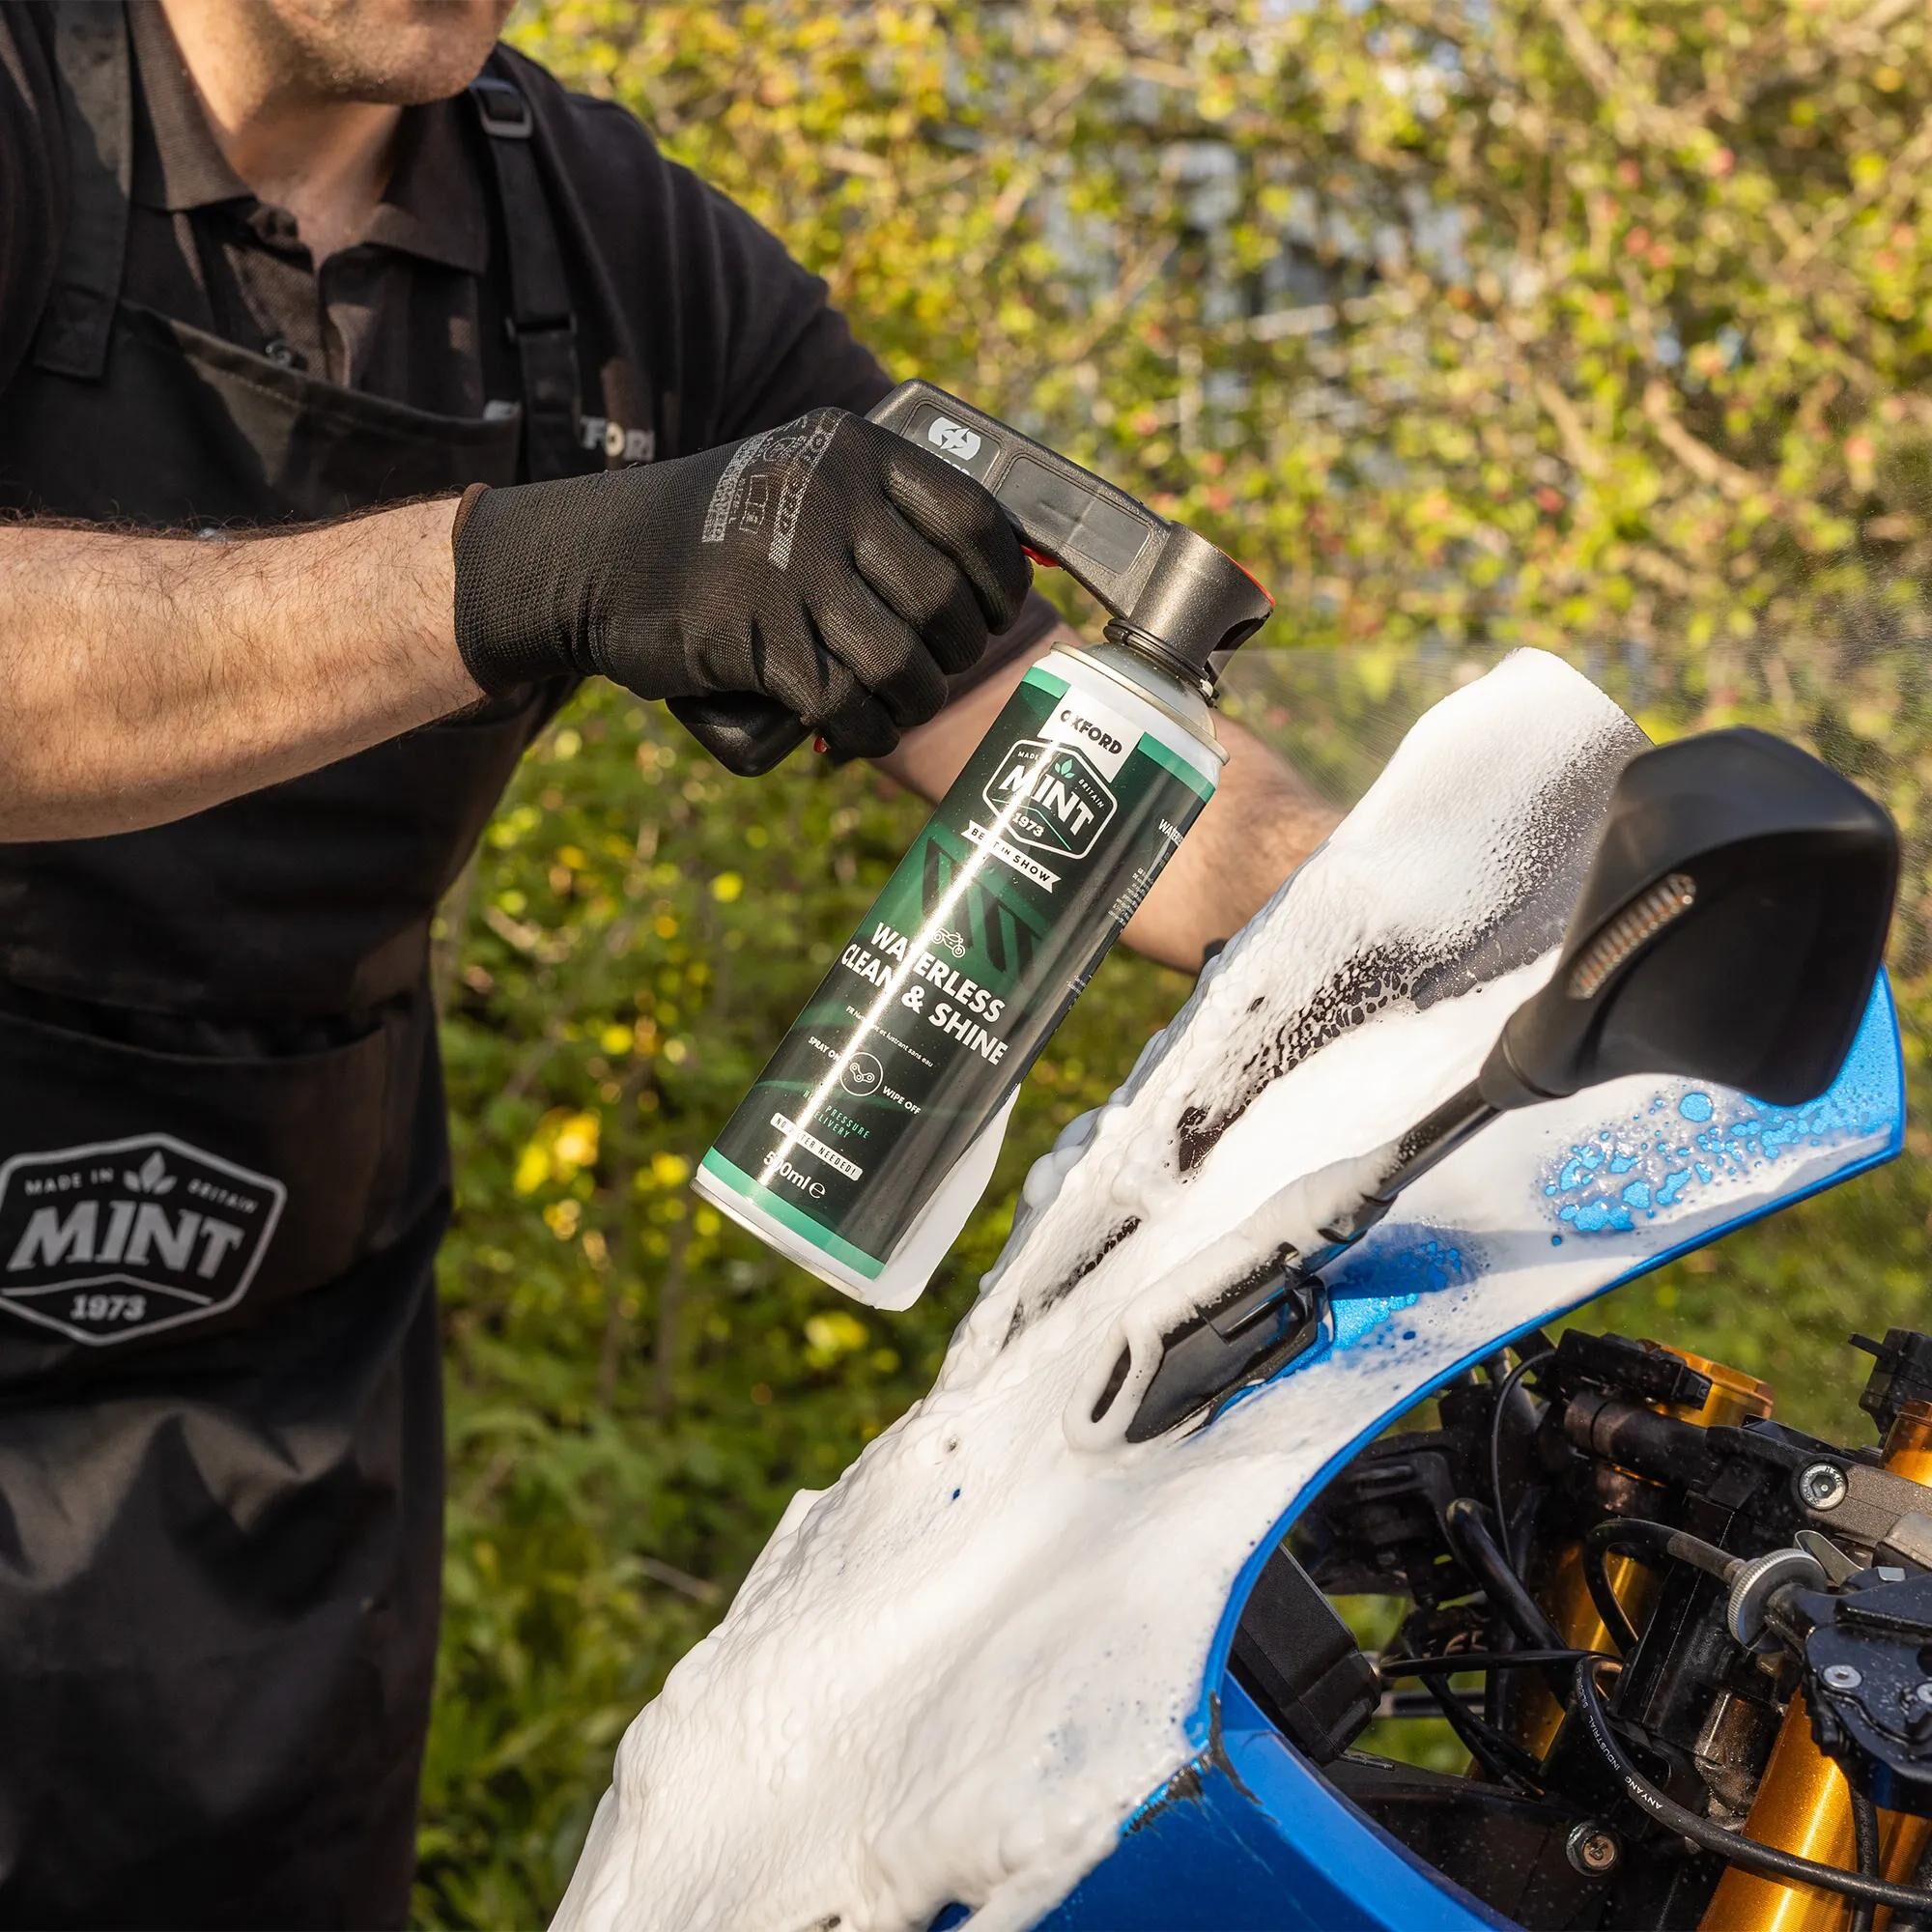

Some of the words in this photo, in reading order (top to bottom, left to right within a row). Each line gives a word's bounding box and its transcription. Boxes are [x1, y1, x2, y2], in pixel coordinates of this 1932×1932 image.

[1060, 709, 1123, 755] OXFORD
[998, 764, 1095, 837] MINT
[1078, 778, 1105, 810] BRITAIN
[1011, 811, 1045, 838] 1973
[971, 828, 1000, 852] BET
[1001, 846, 1011, 857] IN
[1012, 855, 1051, 883] SHOW
[870, 922, 1007, 1023] WAERLESS
[840, 943, 898, 995] CLEAN
[900, 984, 926, 1014] &
[927, 1002, 1009, 1066] SHINE
[808, 1036, 828, 1054] SPRAY
[827, 1049, 843, 1062] ON
[886, 1032, 908, 1053] lustrant
[907, 1048, 922, 1062] sans
[922, 1056, 934, 1068] eau
[882, 1085, 904, 1105] WIPE
[904, 1100, 922, 1116] OFF
[810, 1108, 850, 1139] ELIVERY
[825, 1105, 870, 1140] PRESSURE
[775, 1117, 786, 1130] NO
[818, 1146, 858, 1177] NEEDED!
[25, 1172, 83, 1196] MADE
[91, 1168, 115, 1184] IN
[187, 1179, 259, 1214] BRITAIN
[6, 1200, 245, 1280] MINT
[70, 1293, 147, 1321] 1973
[1589, 1715, 1622, 1771] INDUSTRIAL
[1624, 1776, 1663, 1810] ANYANG
